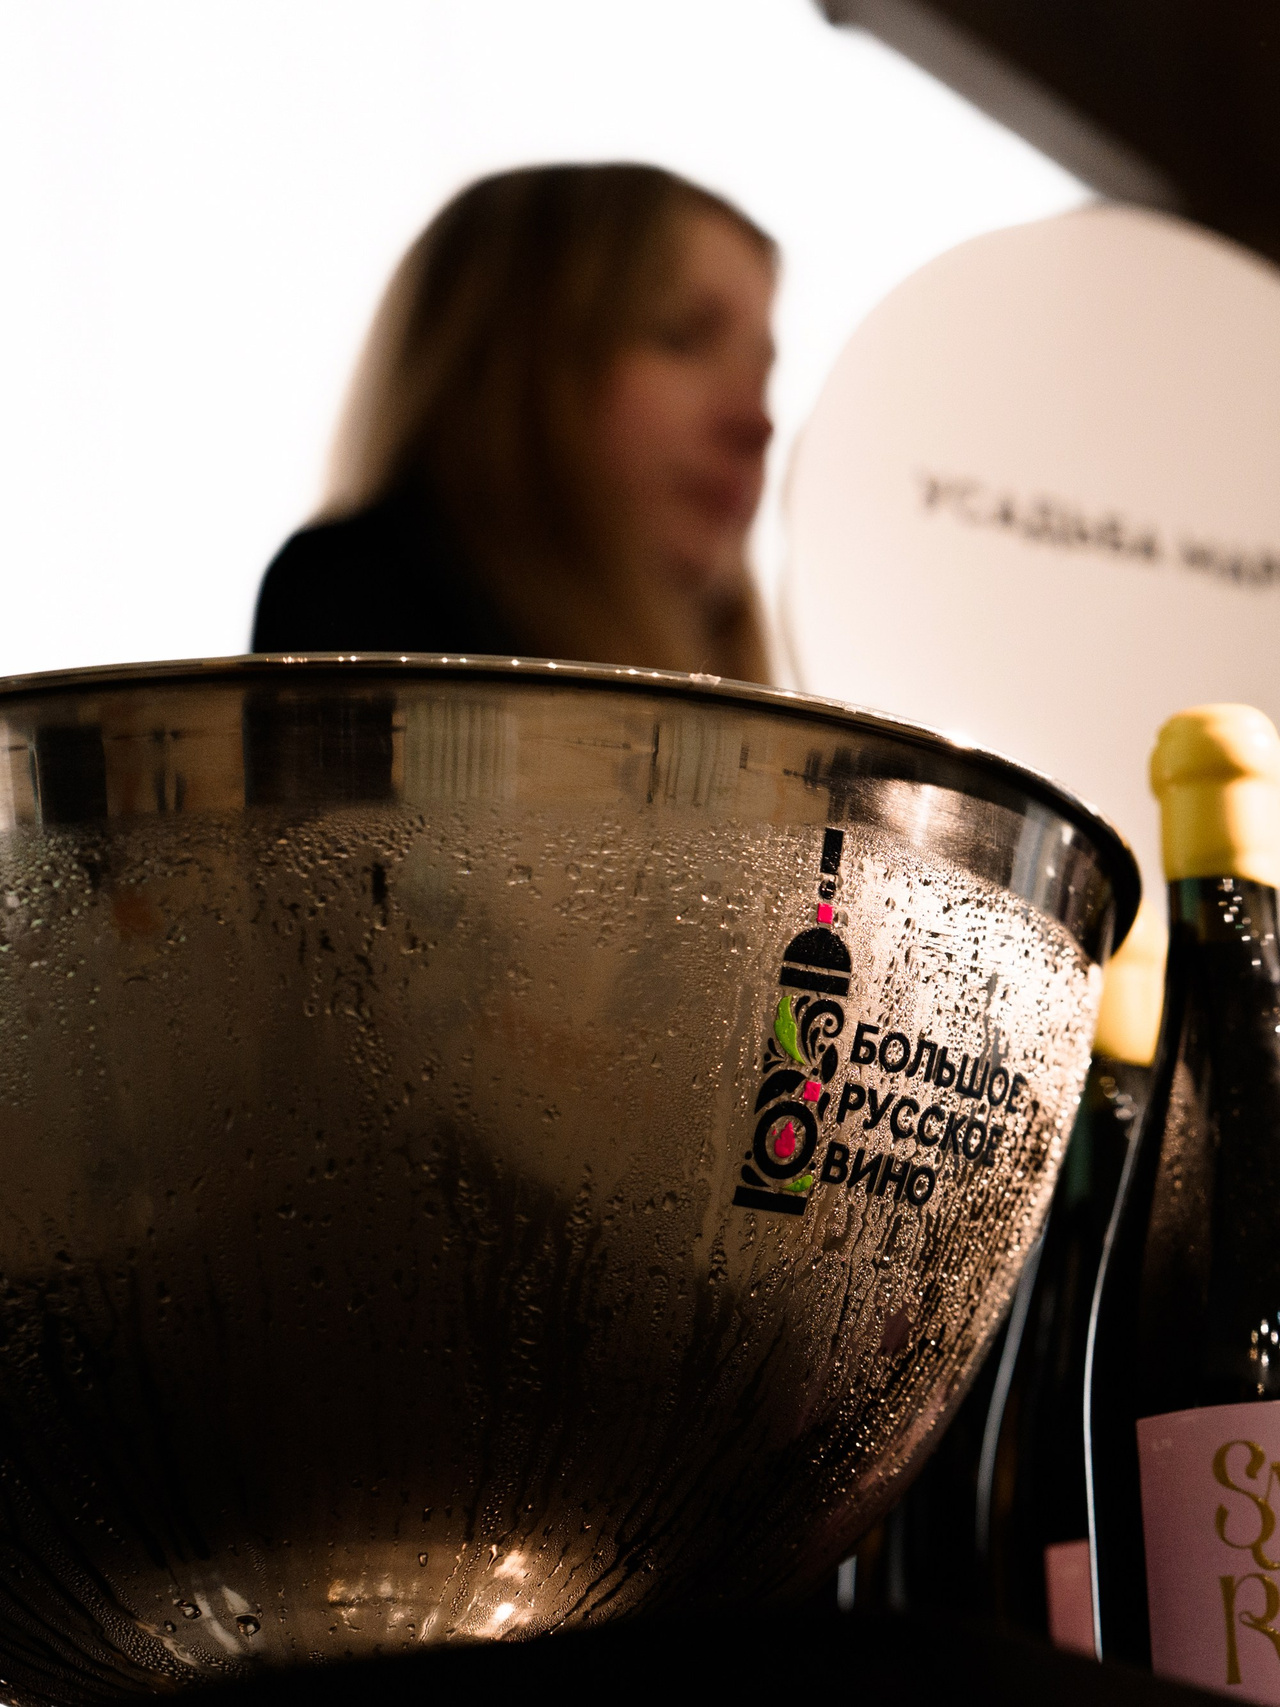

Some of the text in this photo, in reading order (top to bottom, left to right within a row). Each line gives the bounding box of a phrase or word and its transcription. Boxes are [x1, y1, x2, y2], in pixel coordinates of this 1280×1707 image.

[920, 469, 1163, 563] УСАДЬБА
[850, 1021, 1029, 1113] БОЛЬШОЕ
[836, 1083, 1004, 1168] РУССКОЕ
[821, 1140, 936, 1206] ВИНО
